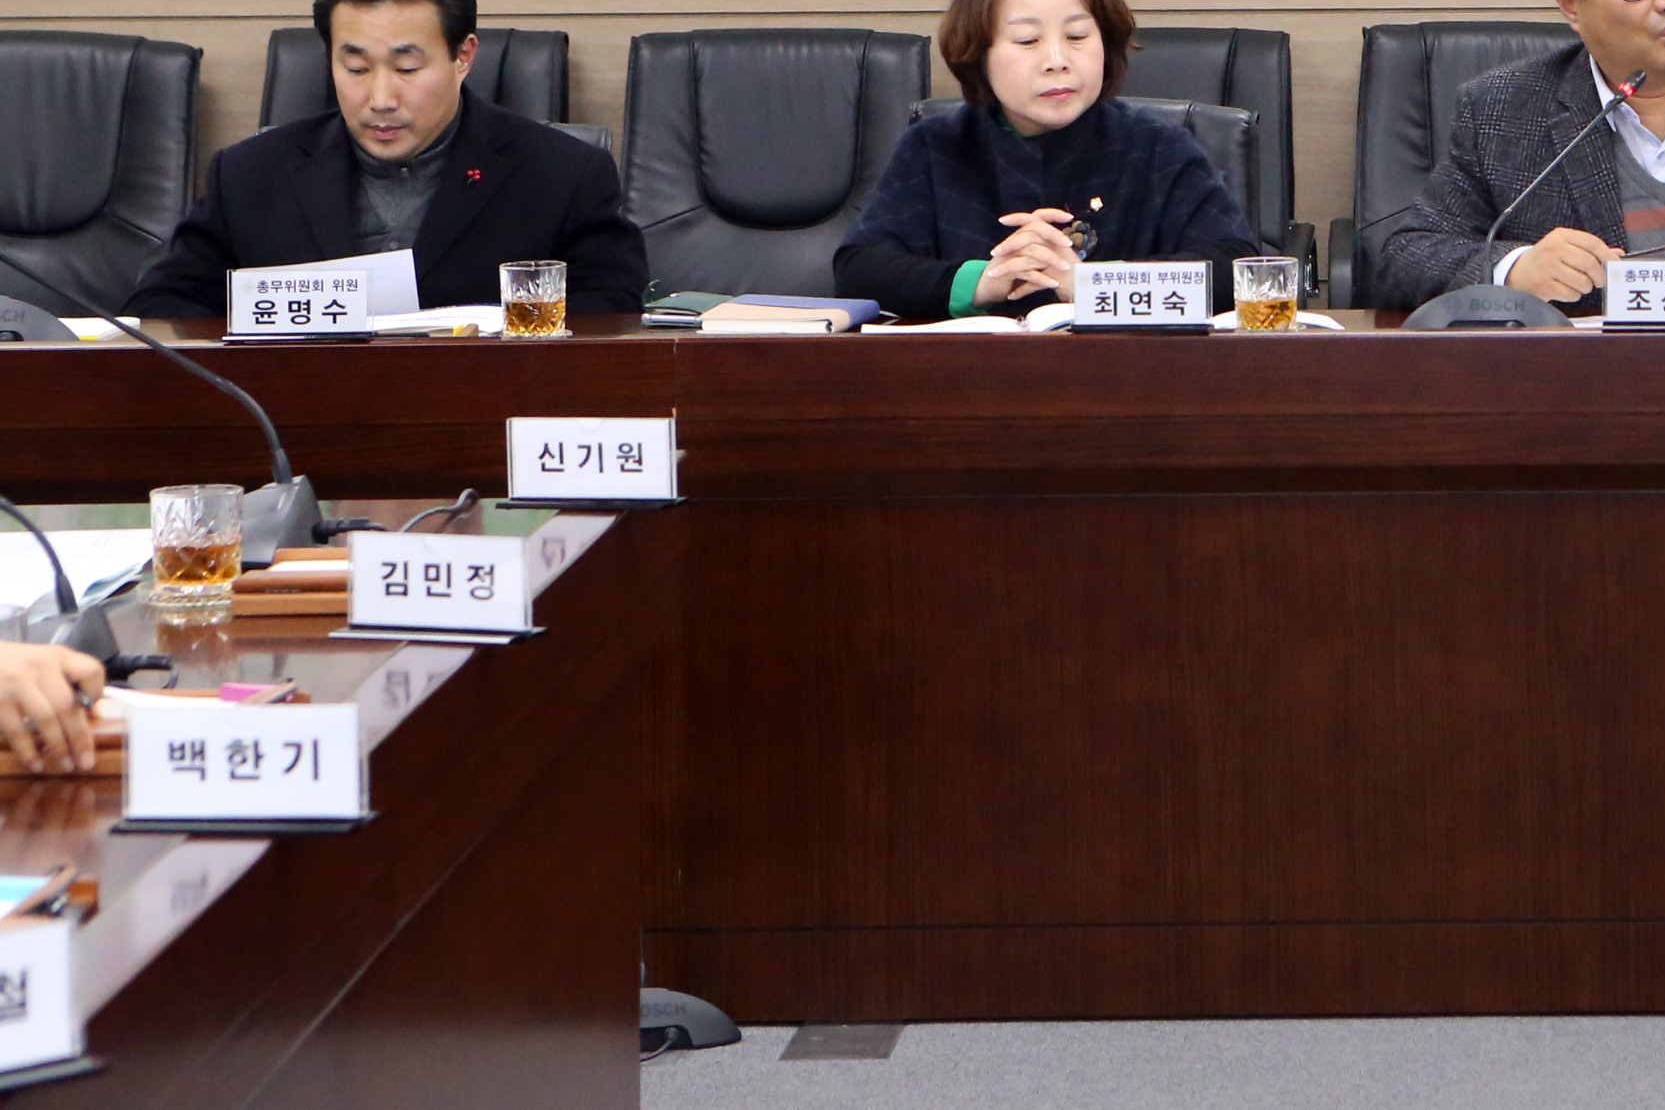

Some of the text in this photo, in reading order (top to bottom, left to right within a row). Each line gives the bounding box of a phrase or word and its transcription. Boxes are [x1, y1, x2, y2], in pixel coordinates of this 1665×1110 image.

[256, 279, 359, 294] 총무위원회 위원
[1092, 271, 1205, 286] 총무위원회 부위원장
[251, 298, 348, 325] 윤명수
[1094, 291, 1188, 317] 최연숙
[1468, 299, 1526, 312] BOSCH
[538, 441, 645, 474] 신기원
[380, 559, 496, 601] 김민정
[167, 736, 321, 782] 백한기
